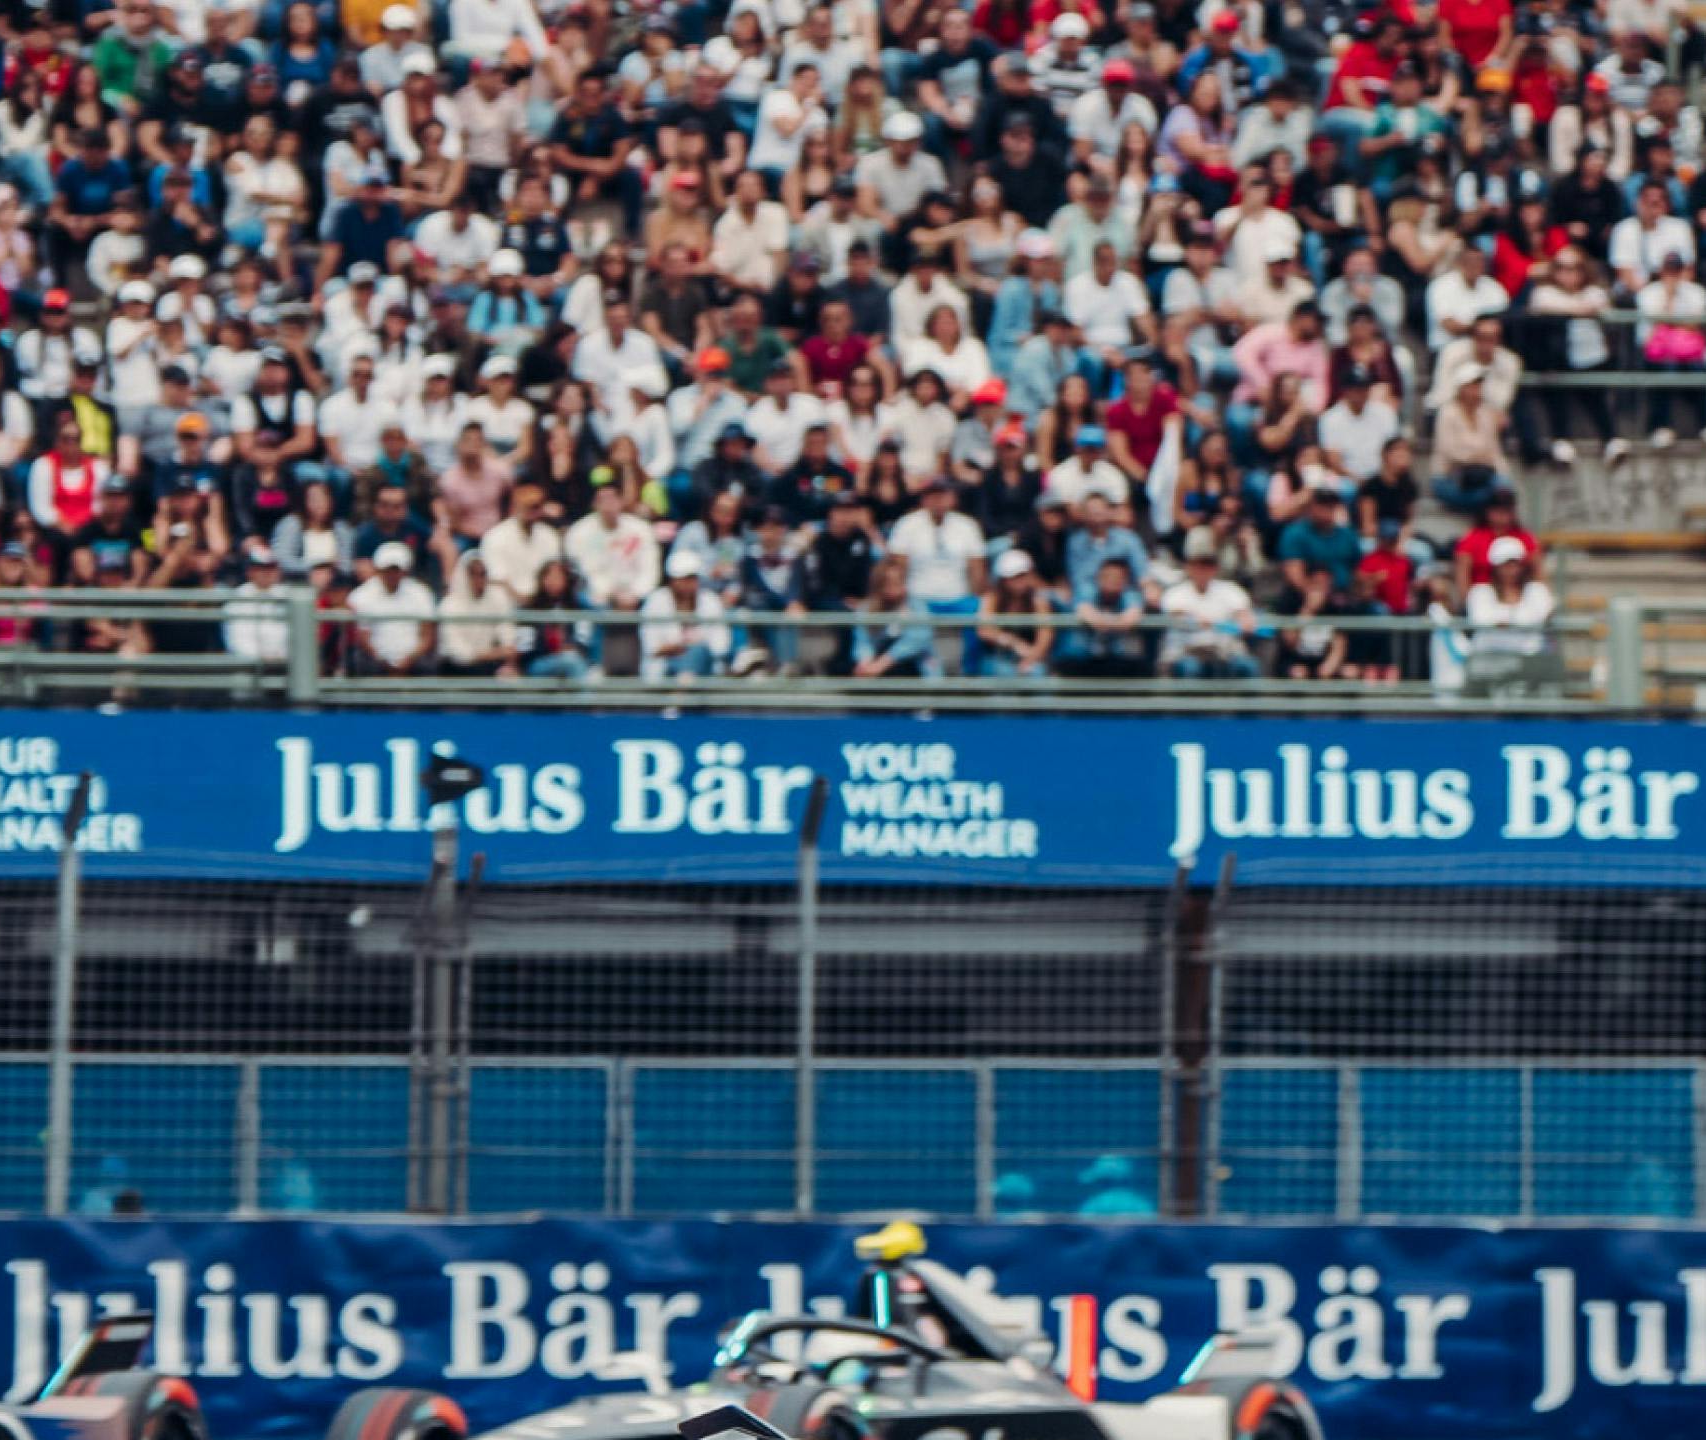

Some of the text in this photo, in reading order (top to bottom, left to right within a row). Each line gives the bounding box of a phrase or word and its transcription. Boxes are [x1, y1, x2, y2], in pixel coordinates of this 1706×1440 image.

[613, 738, 812, 834] Bär
[841, 741, 955, 781] YOUR
[841, 780, 1003, 819] WEALTH
[1169, 741, 1698, 859] Julius Bär
[841, 819, 1038, 859] MANAGER
[442, 1261, 701, 1380] Bär
[1207, 1262, 1469, 1381] Bär
